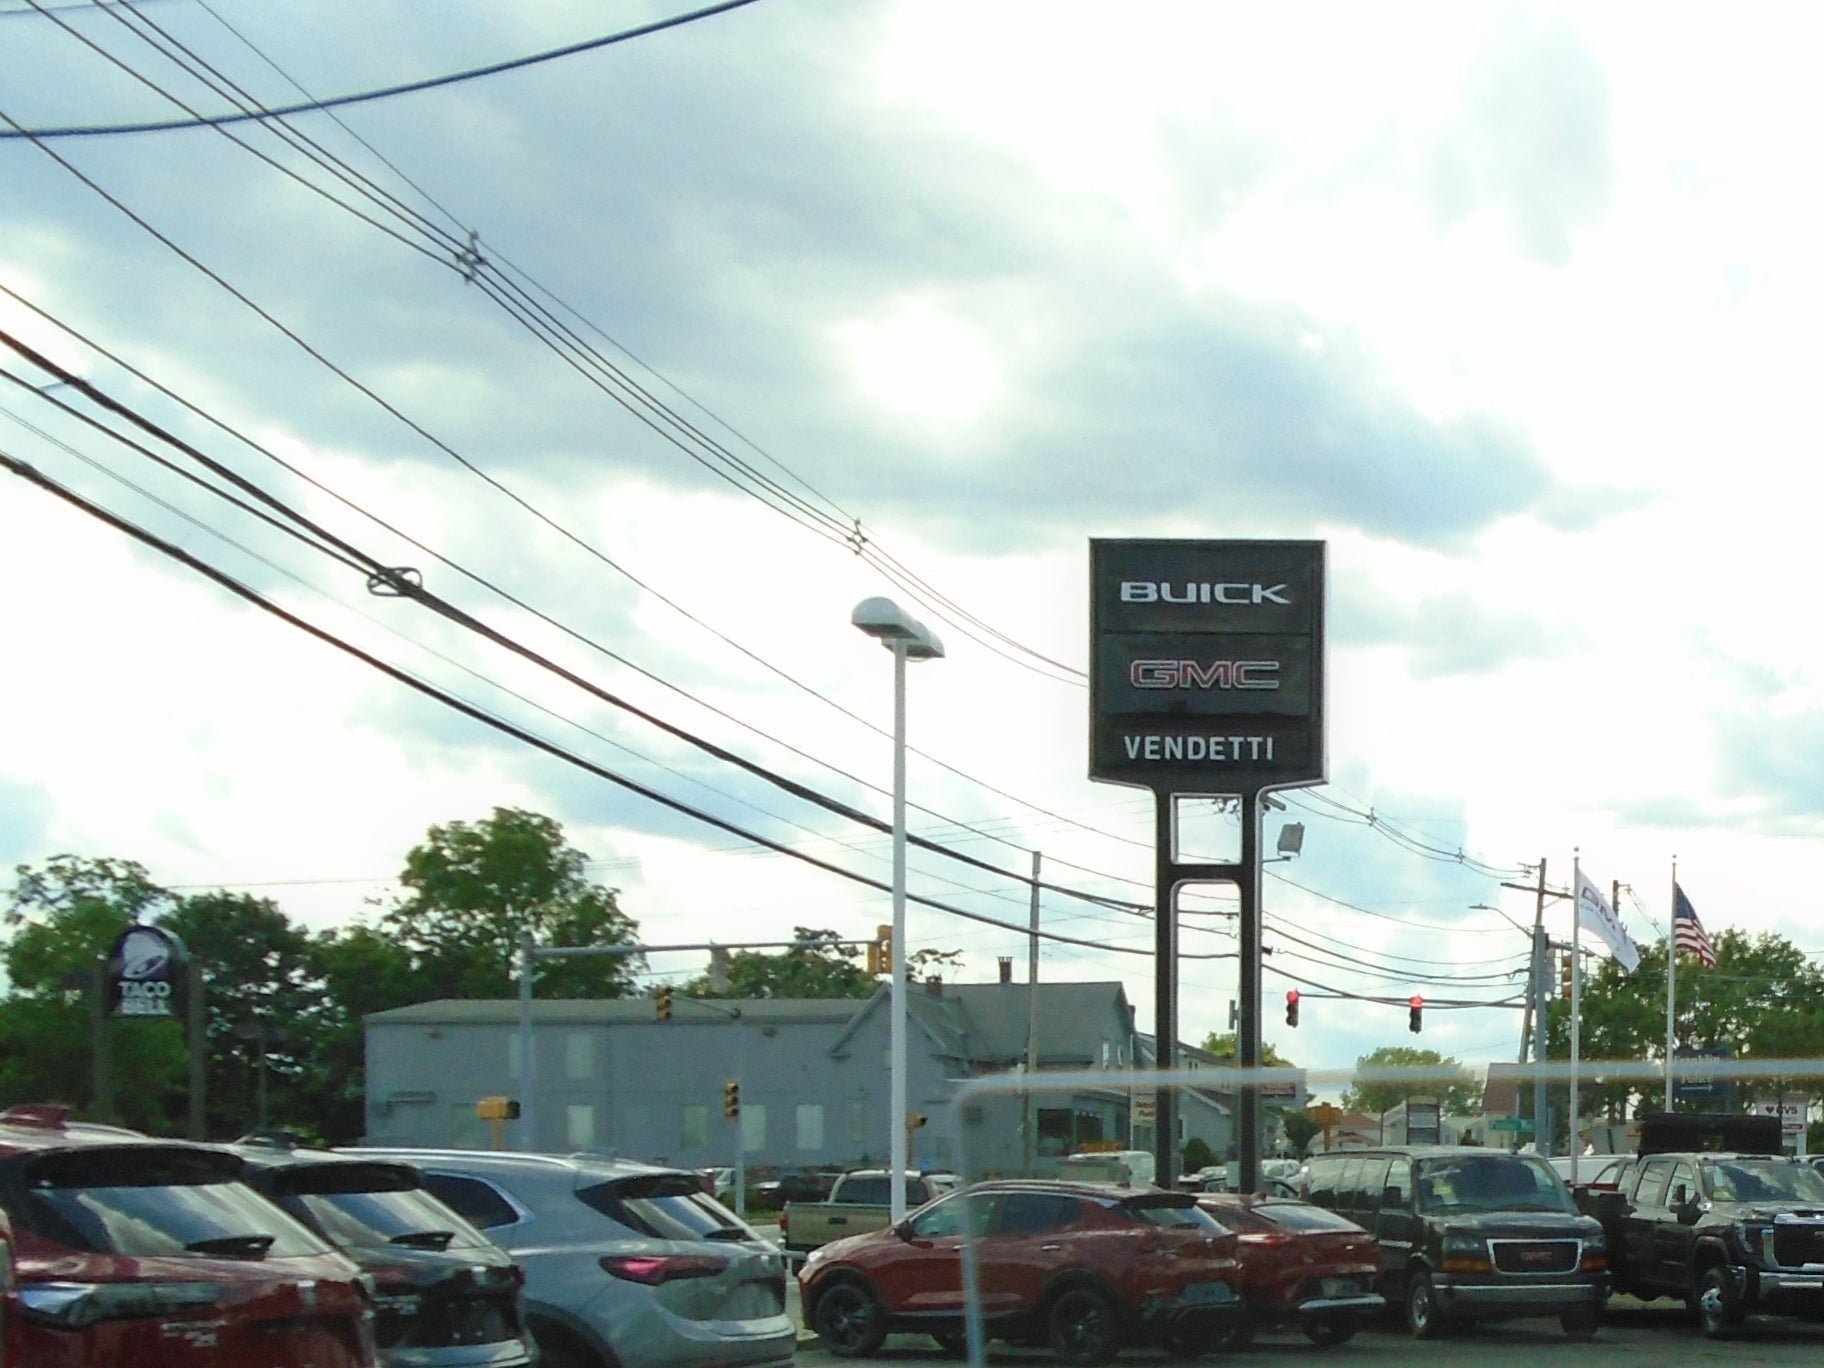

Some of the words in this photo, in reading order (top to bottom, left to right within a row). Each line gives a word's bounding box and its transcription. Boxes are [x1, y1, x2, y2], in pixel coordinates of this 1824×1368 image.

[1120, 581, 1291, 605] BUICK
[1130, 659, 1280, 689] GMC
[1124, 734, 1274, 761] VENDETTI
[118, 981, 171, 997] TACO
[1776, 1105, 1798, 1115] CVS
